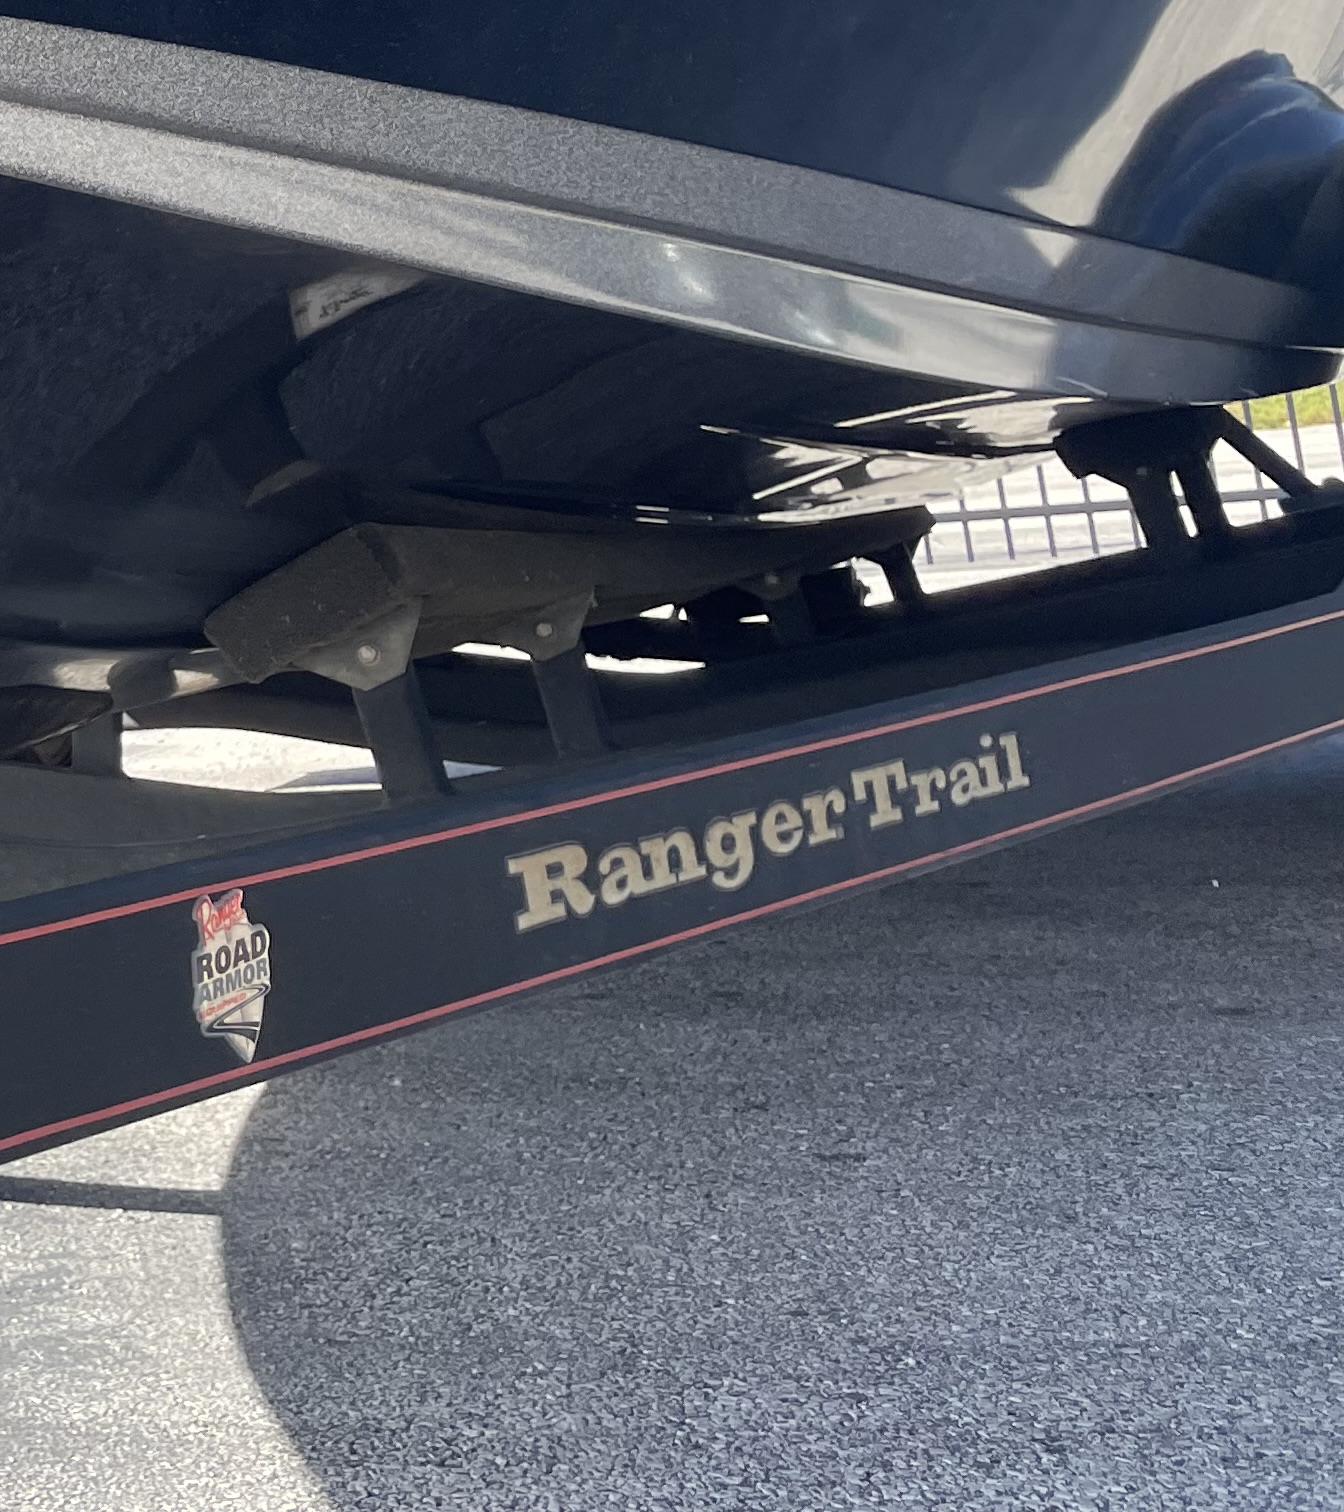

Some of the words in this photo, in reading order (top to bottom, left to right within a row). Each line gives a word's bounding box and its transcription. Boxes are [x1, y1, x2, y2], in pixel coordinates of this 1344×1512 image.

[196, 893, 241, 946] Ranger
[197, 930, 266, 984] ROAD
[199, 957, 268, 1006] ARMOR
